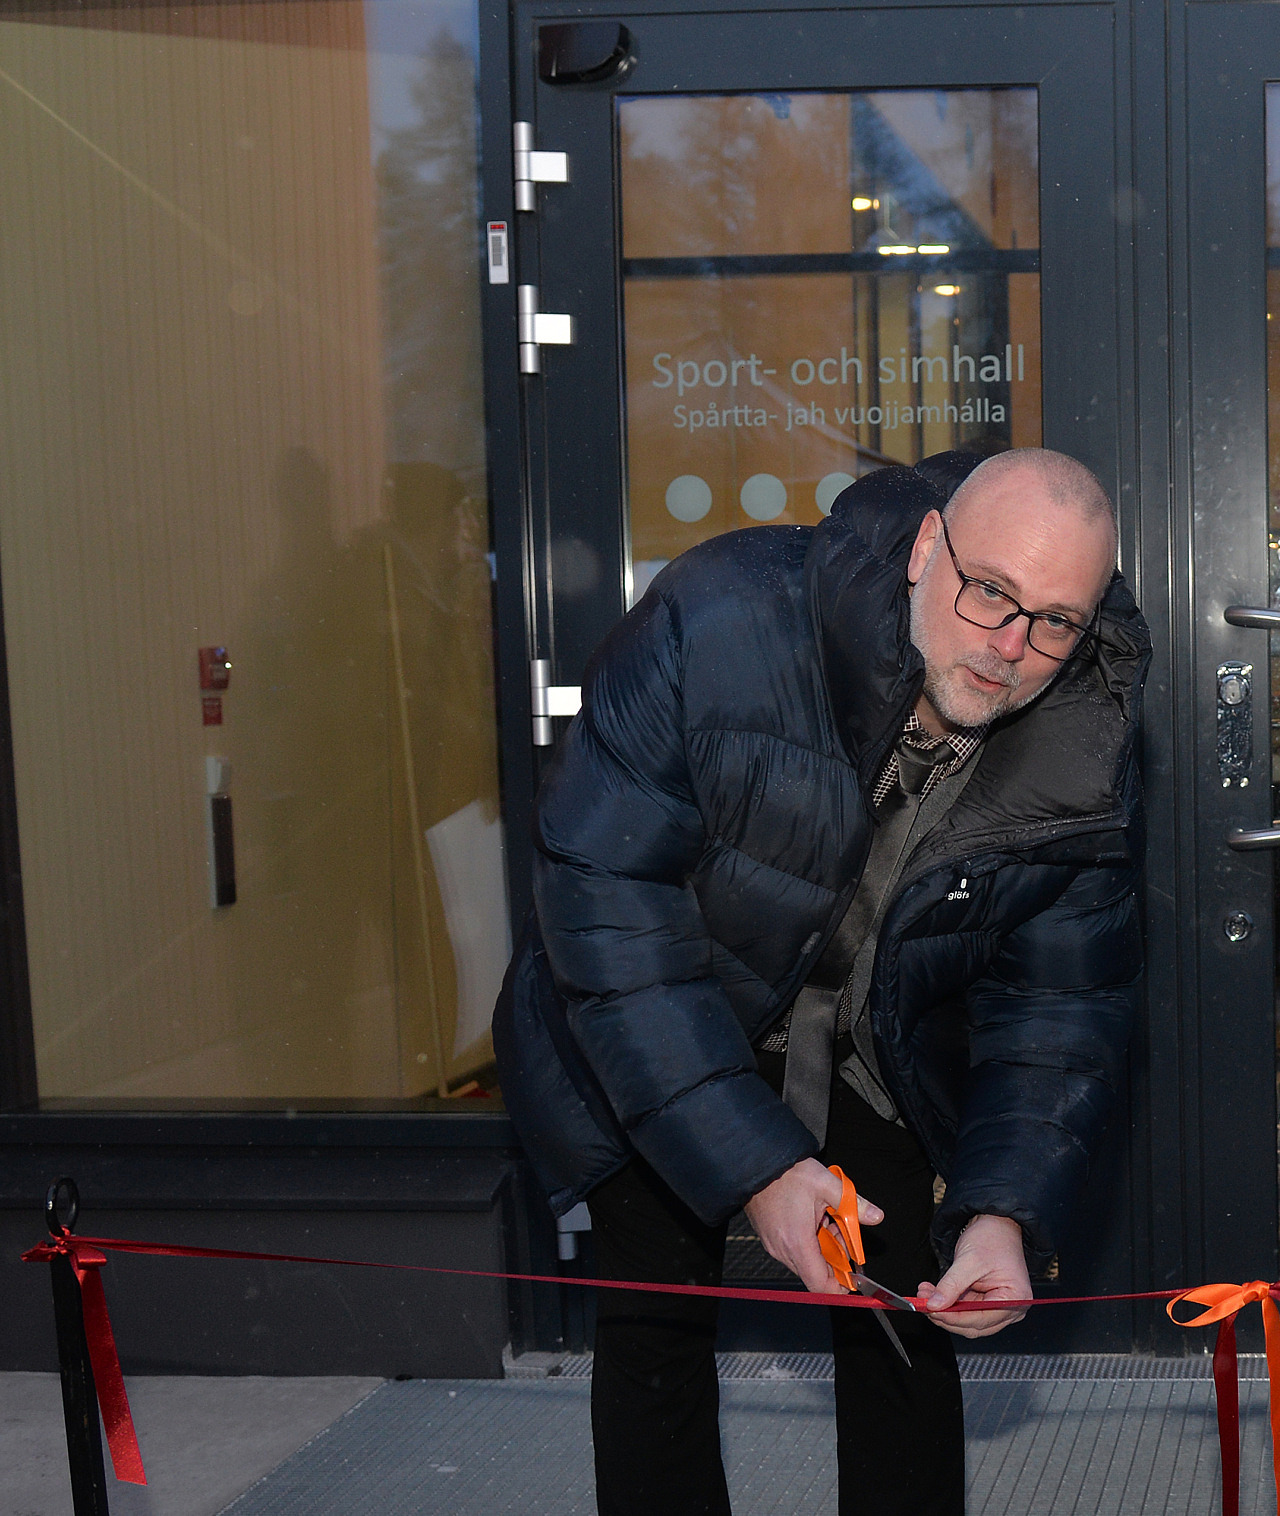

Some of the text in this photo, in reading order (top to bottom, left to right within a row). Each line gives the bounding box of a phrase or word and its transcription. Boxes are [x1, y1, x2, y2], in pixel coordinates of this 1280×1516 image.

[652, 344, 1025, 396] Sport- och simhall
[673, 398, 1006, 433] Spårtta- jah vuojjamhálla
[946, 891, 970, 901] glöfs
